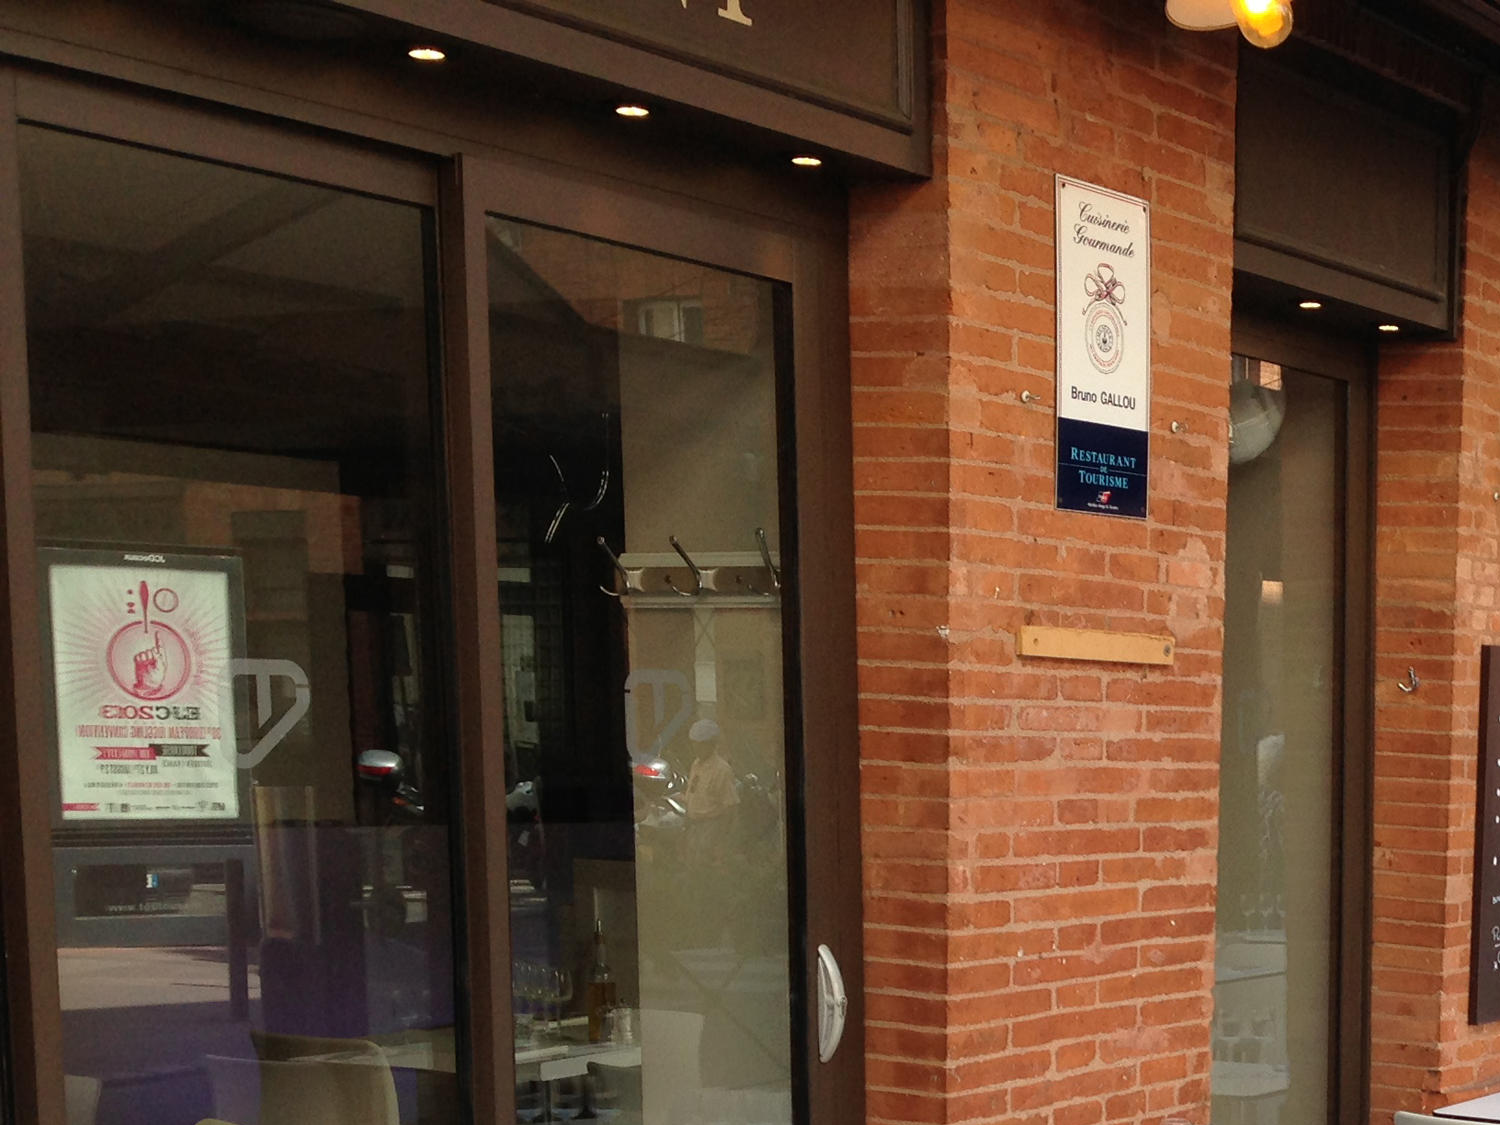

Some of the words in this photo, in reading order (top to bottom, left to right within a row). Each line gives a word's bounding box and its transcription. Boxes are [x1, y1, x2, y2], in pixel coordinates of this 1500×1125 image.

[1078, 201, 1131, 234] Cuisinerie
[1073, 223, 1136, 258] Gourmande
[1071, 385, 1097, 404] Bruno
[1100, 391, 1136, 410] GALLOU
[1070, 446, 1137, 469] RESTAURANT
[1078, 469, 1129, 489] TOURISME
